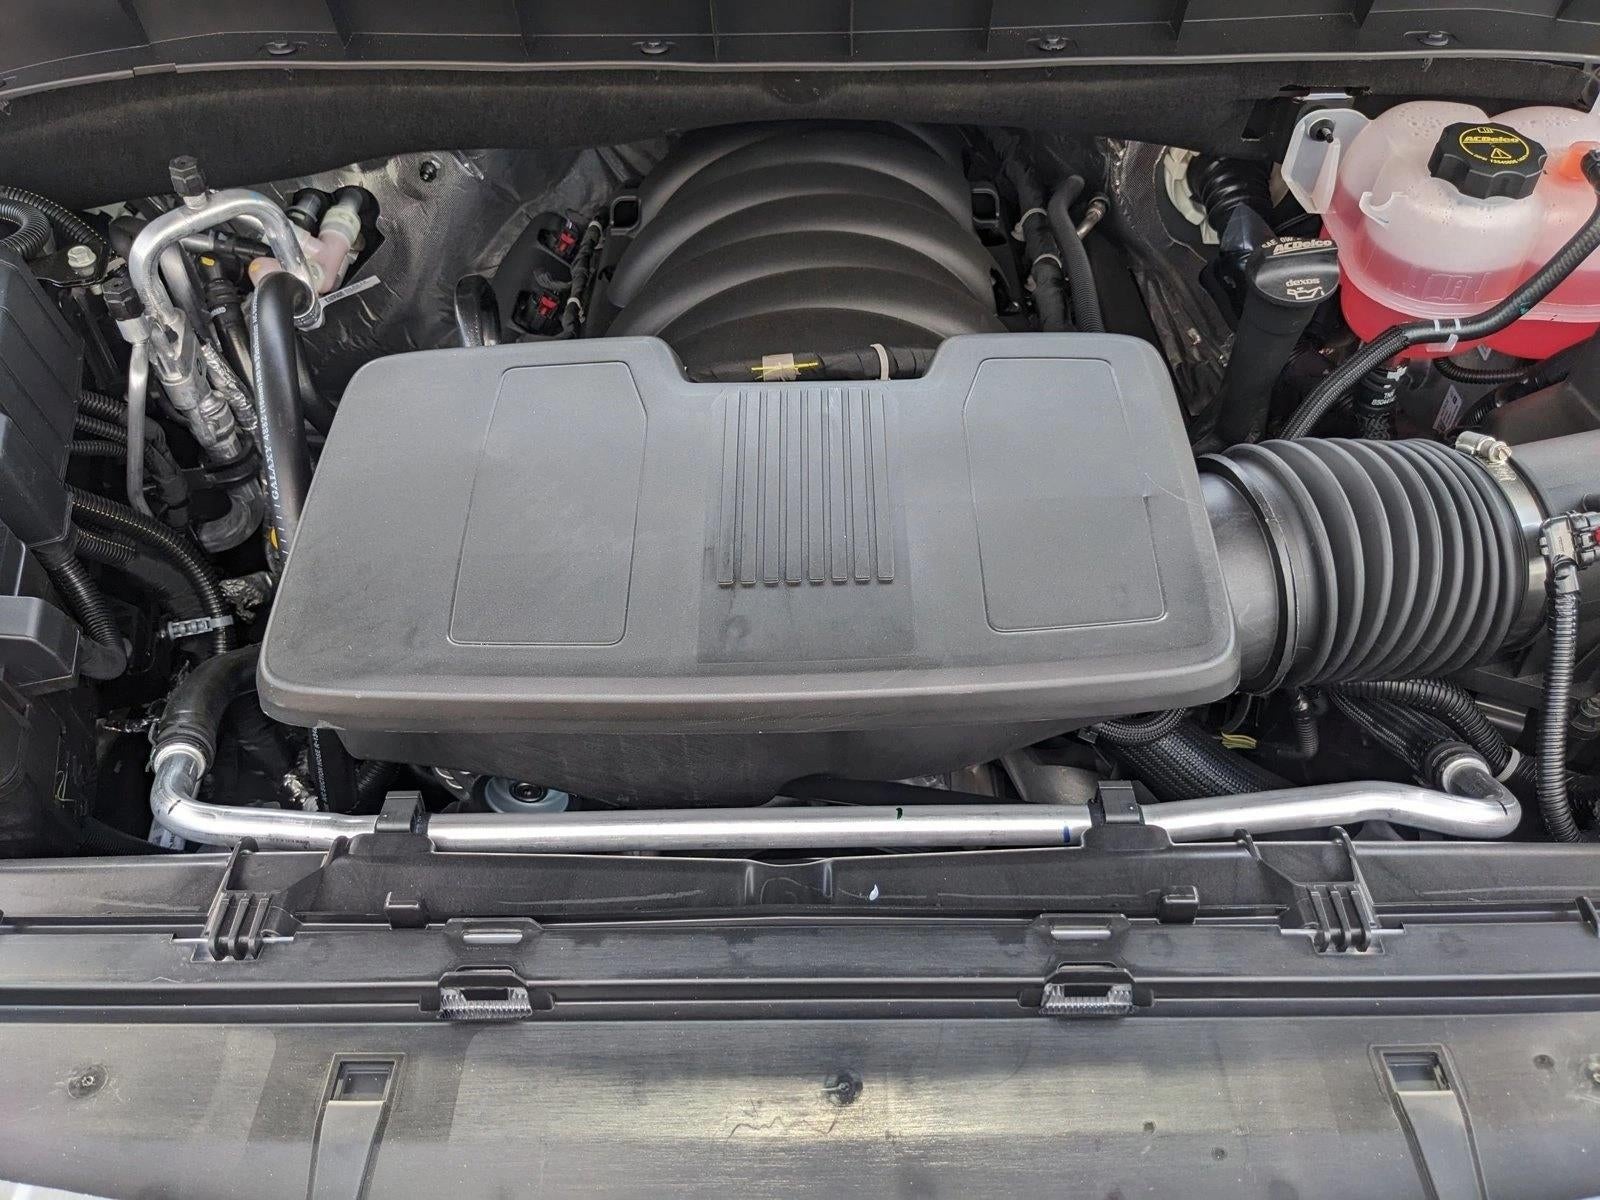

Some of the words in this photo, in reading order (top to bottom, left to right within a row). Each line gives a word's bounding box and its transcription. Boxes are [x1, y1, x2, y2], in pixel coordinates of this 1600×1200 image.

[1273, 239, 1332, 255] ACDelco
[1286, 278, 1320, 287] dexos
[265, 444, 279, 500] GALAXY
